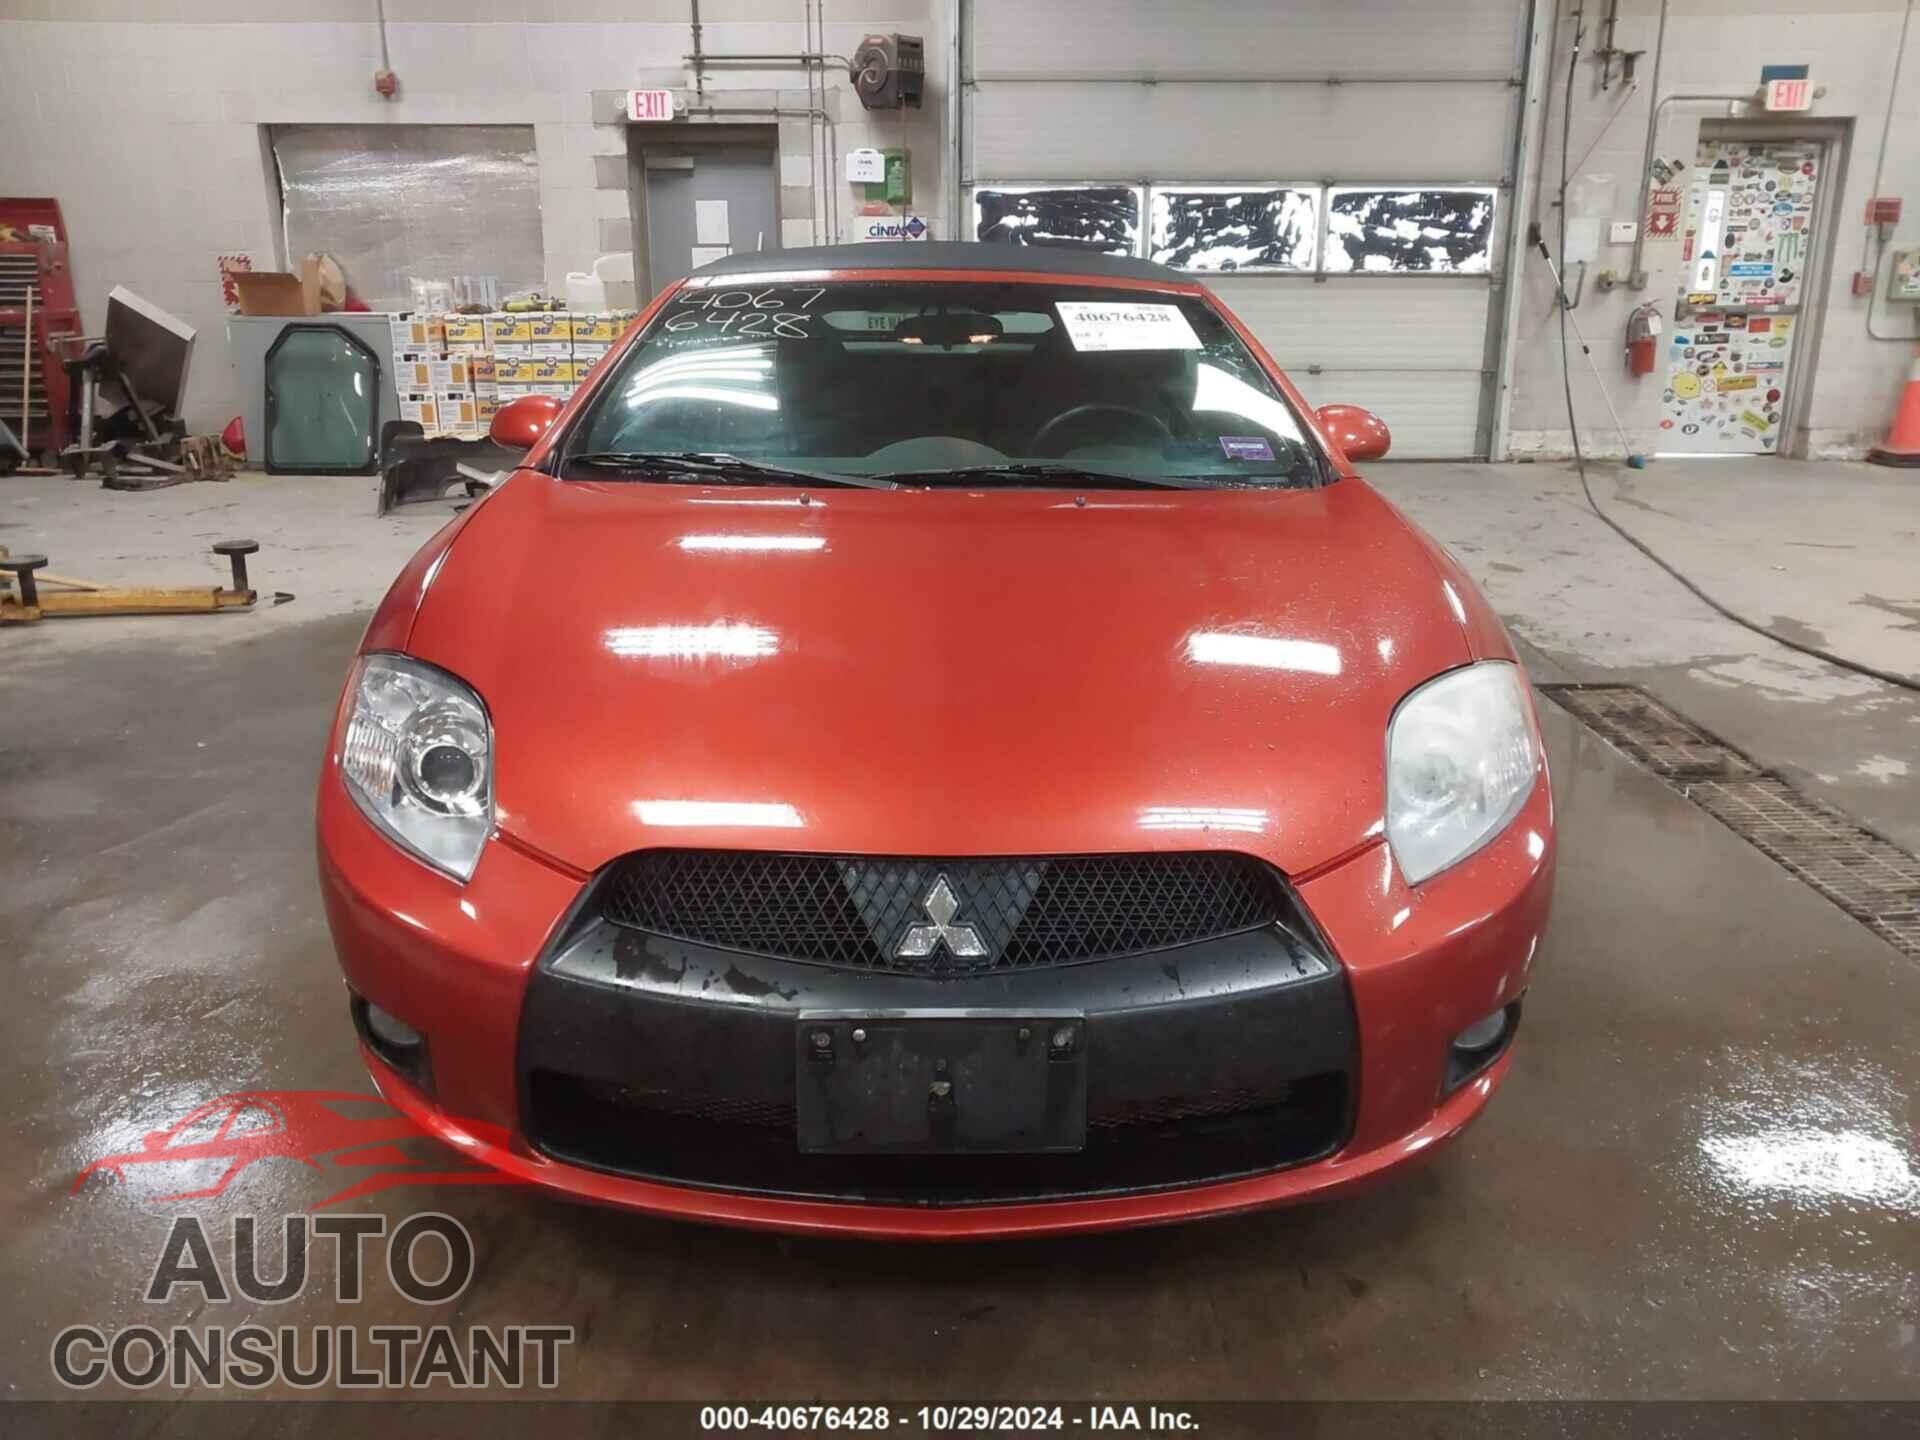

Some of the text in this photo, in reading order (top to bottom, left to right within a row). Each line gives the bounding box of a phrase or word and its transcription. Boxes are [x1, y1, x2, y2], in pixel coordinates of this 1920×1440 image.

[1775, 82, 1808, 107] EXIT
[635, 92, 666, 118] EXIT
[679, 288, 826, 309] 4067
[1074, 312, 1171, 322] 40676428
[665, 310, 811, 339] 6428
[495, 327, 514, 336] DEF
[534, 326, 553, 335] DEF
[575, 327, 594, 335] DEF
[498, 369, 517, 377] DEF
[536, 368, 555, 376] DEF
